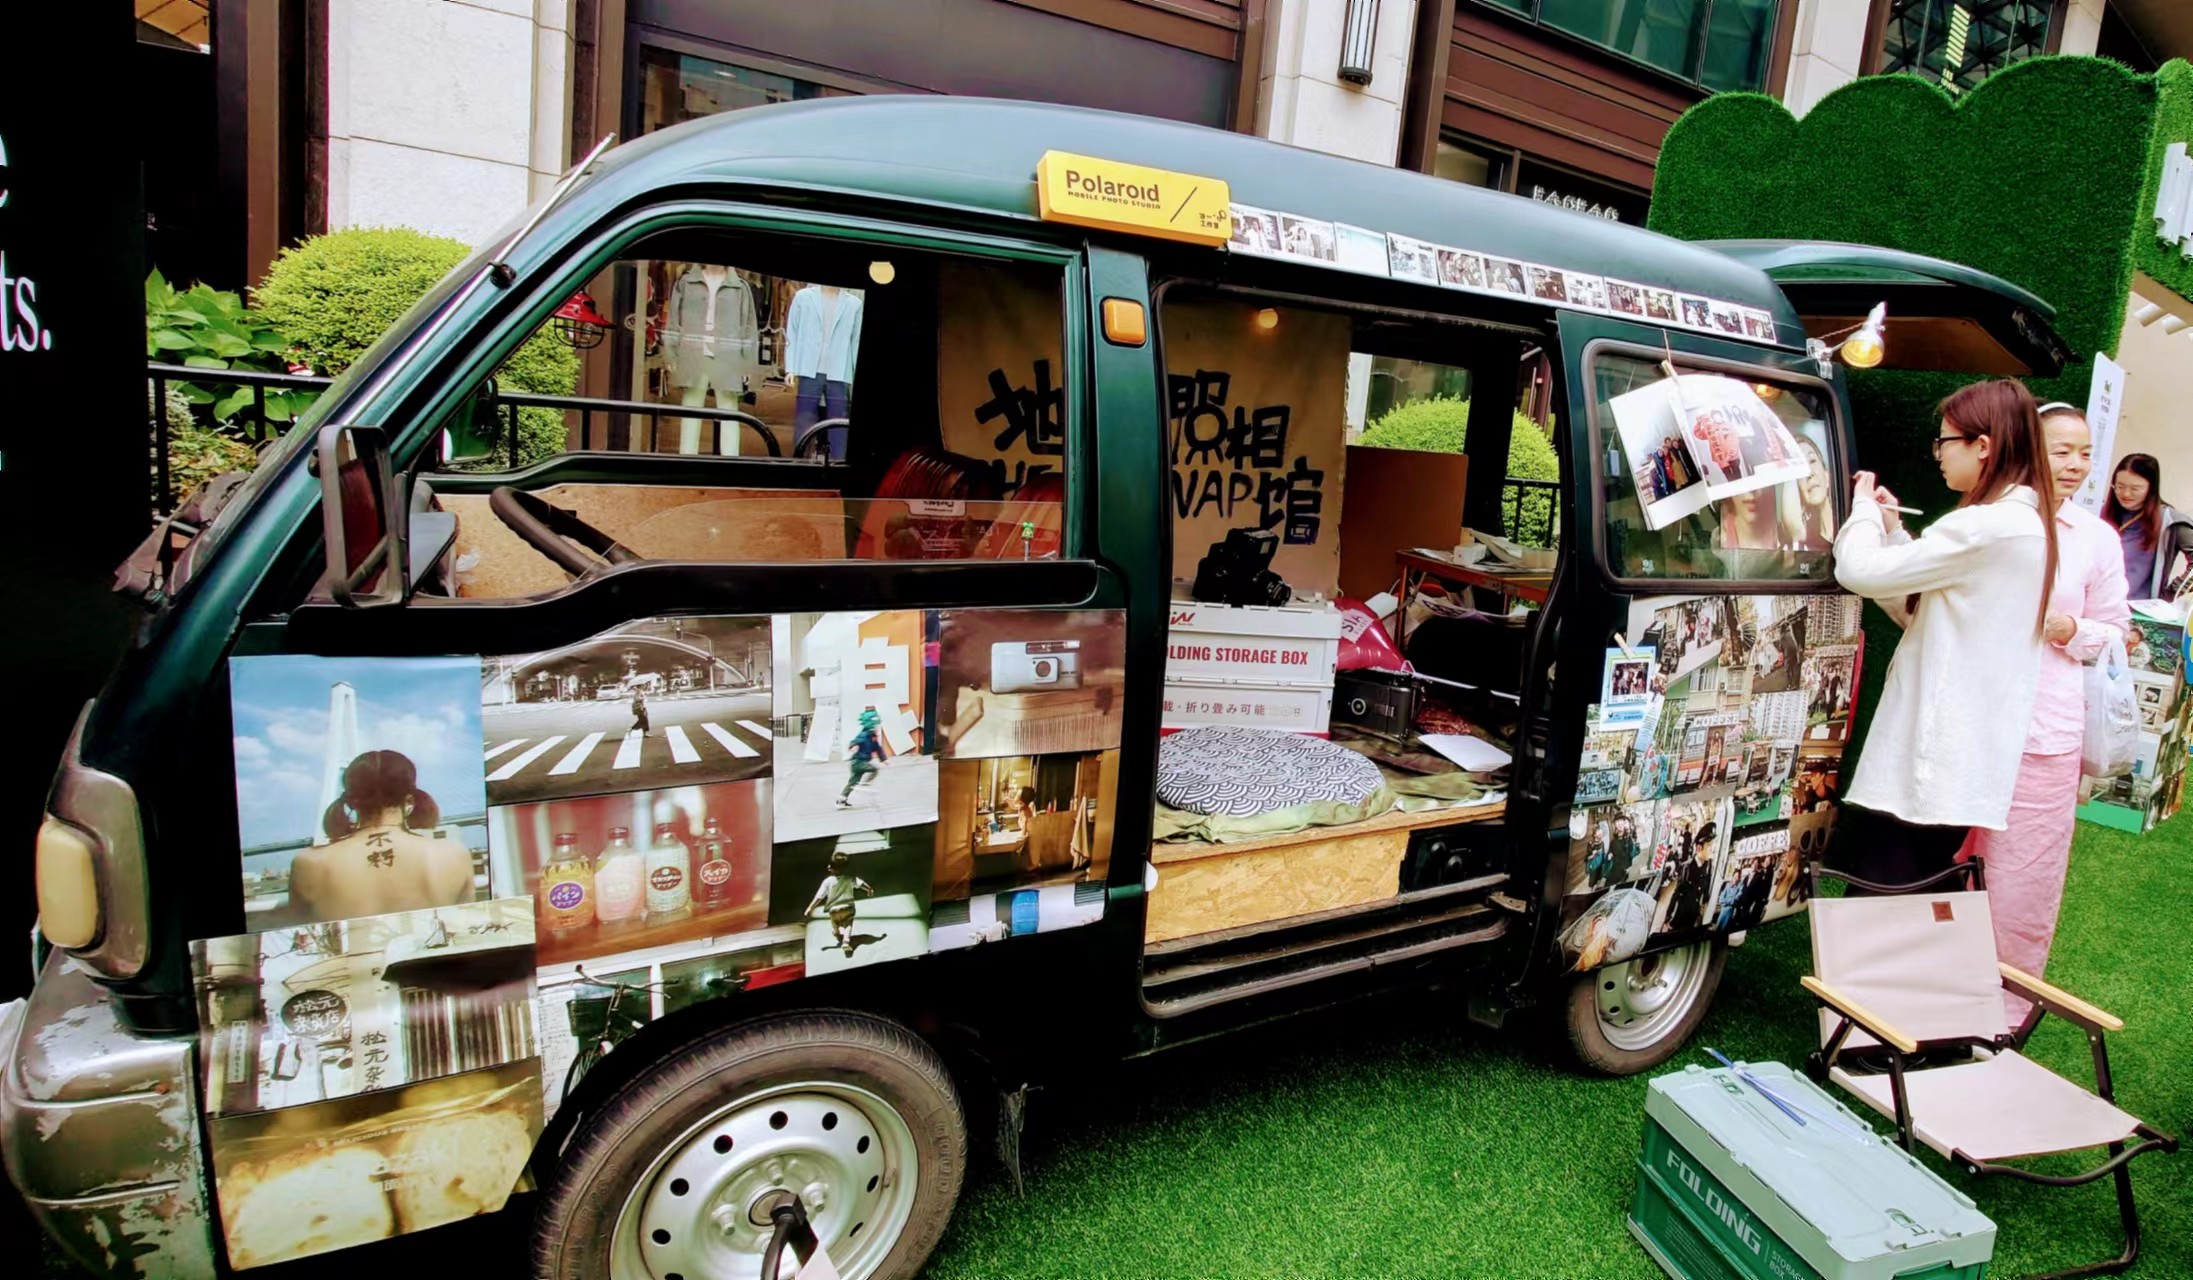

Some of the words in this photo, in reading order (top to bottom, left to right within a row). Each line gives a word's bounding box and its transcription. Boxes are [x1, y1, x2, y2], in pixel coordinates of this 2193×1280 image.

[1066, 169, 1160, 202] Polaroid
[1067, 190, 1098, 201] MOBILE
[1101, 195, 1129, 205] PHOTO
[1215, 648, 1277, 664] STORAGE
[1280, 651, 1309, 666] BOX
[1666, 1148, 1763, 1256] FOLDING
